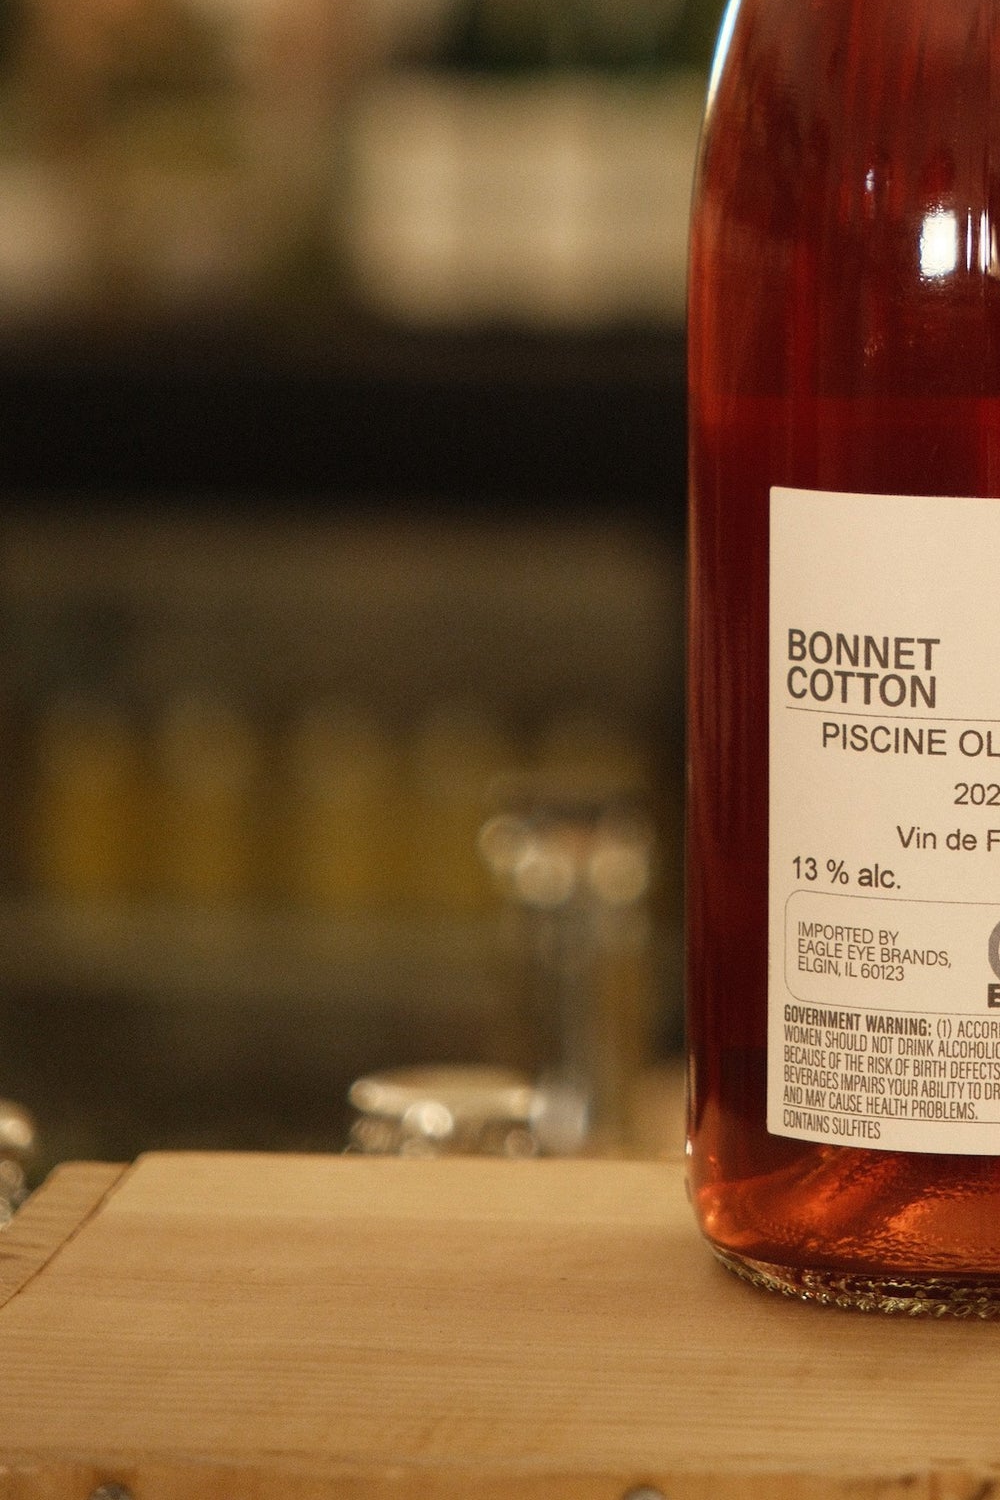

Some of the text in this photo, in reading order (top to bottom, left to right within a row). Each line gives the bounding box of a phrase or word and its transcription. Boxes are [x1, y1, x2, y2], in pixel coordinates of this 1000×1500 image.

[788, 628, 940, 670] BONNET
[786, 666, 936, 708] COTTON
[822, 722, 947, 755] PISCINE
[897, 826, 937, 850] Vin
[946, 828, 977, 851] de
[791, 856, 901, 889] 13 % alc.
[798, 921, 899, 946] IMPORTED BY
[797, 955, 905, 982] ELGIN, IL 60123
[798, 939, 952, 969] EAGLE EYE BRANDS,
[784, 1004, 861, 1031] GOVERNMENT
[866, 1015, 932, 1036] WARNING:
[936, 1019, 951, 1038] (1)
[784, 1024, 822, 1047] WOMEN
[825, 1030, 867, 1052] SHOULD
[872, 1036, 893, 1054] NOT
[898, 1038, 934, 1056] DRINK
[784, 1045, 826, 1068] BECAUSE
[829, 1052, 843, 1069] OF
[844, 1053, 864, 1073] THE
[867, 1056, 892, 1074] RISK
[895, 1058, 910, 1076] OF
[913, 1060, 946, 1078] BIRTH
[784, 1065, 839, 1090] BEVERAGES
[841, 1074, 885, 1094] IMPAIRS
[888, 1078, 918, 1097] YOUR
[921, 1080, 965, 1099] ABILITY
[967, 1082, 981, 1100] TO
[784, 1085, 978, 1120] AND MAY CAUSE HEALTH PROBLEMS.
[784, 1109, 880, 1139] CONTAINS SULFITES
